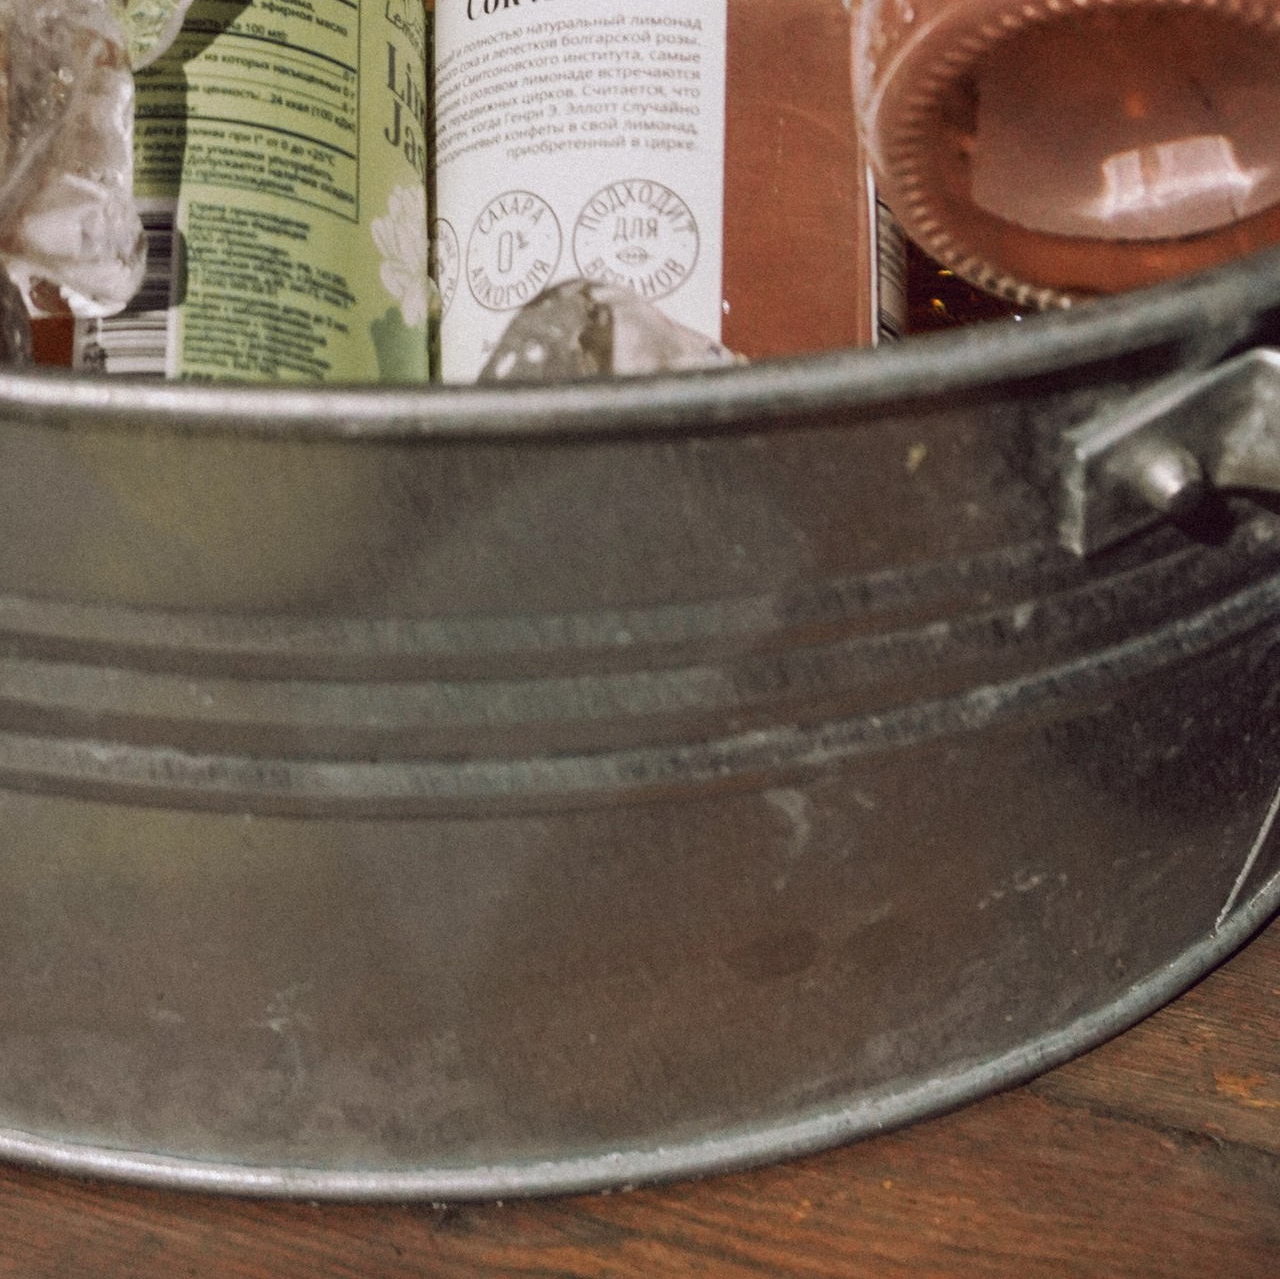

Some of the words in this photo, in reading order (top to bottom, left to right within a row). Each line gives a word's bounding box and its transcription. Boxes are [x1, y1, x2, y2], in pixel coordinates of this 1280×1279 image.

[526, 13, 626, 36] натуральный
[630, 16, 703, 31] лимонад
[492, 38, 557, 60] лепестков
[561, 31, 651, 47] болгарской
[655, 34, 701, 47] розы.
[563, 48, 644, 64] института,
[649, 50, 701, 64] самые
[521, 68, 593, 87] лимонаде
[597, 67, 701, 81] встречаются
[521, 88, 576, 105] цирков.
[581, 84, 666, 98] Считается,
[673, 87, 700, 98] что
[504, 109, 545, 124] Генри
[622, 102, 700, 116] случайно
[504, 124, 564, 142] конфеты
[568, 123, 577, 133] в
[581, 120, 618, 132] свой
[505, 135, 626, 160] приобретенный
[631, 138, 640, 148] в
[478, 195, 547, 236] САХАРА
[578, 180, 698, 233] ПОДХОДИТ
[614, 216, 660, 242] ДЛЯ
[471, 257, 551, 307] АЛКОГОЛЯ
